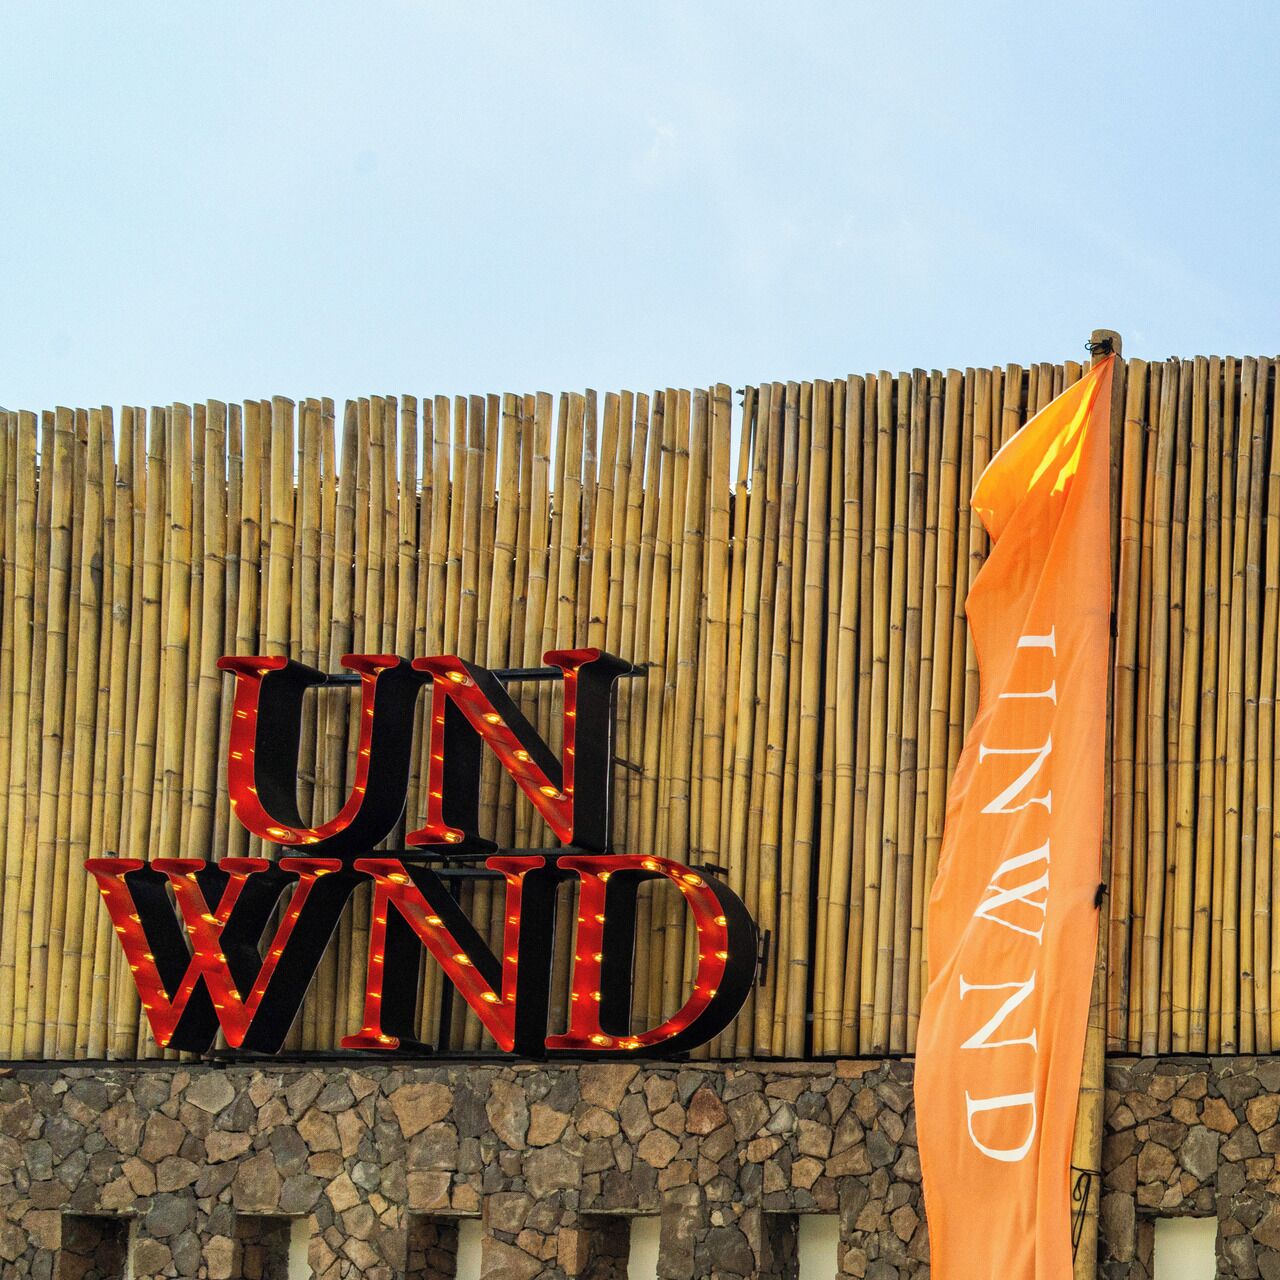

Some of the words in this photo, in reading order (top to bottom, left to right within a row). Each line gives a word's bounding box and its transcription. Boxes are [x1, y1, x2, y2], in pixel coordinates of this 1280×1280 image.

[215, 647, 632, 854] UN
[83, 853, 756, 1055] WND
[959, 624, 1057, 1162] UNWND
